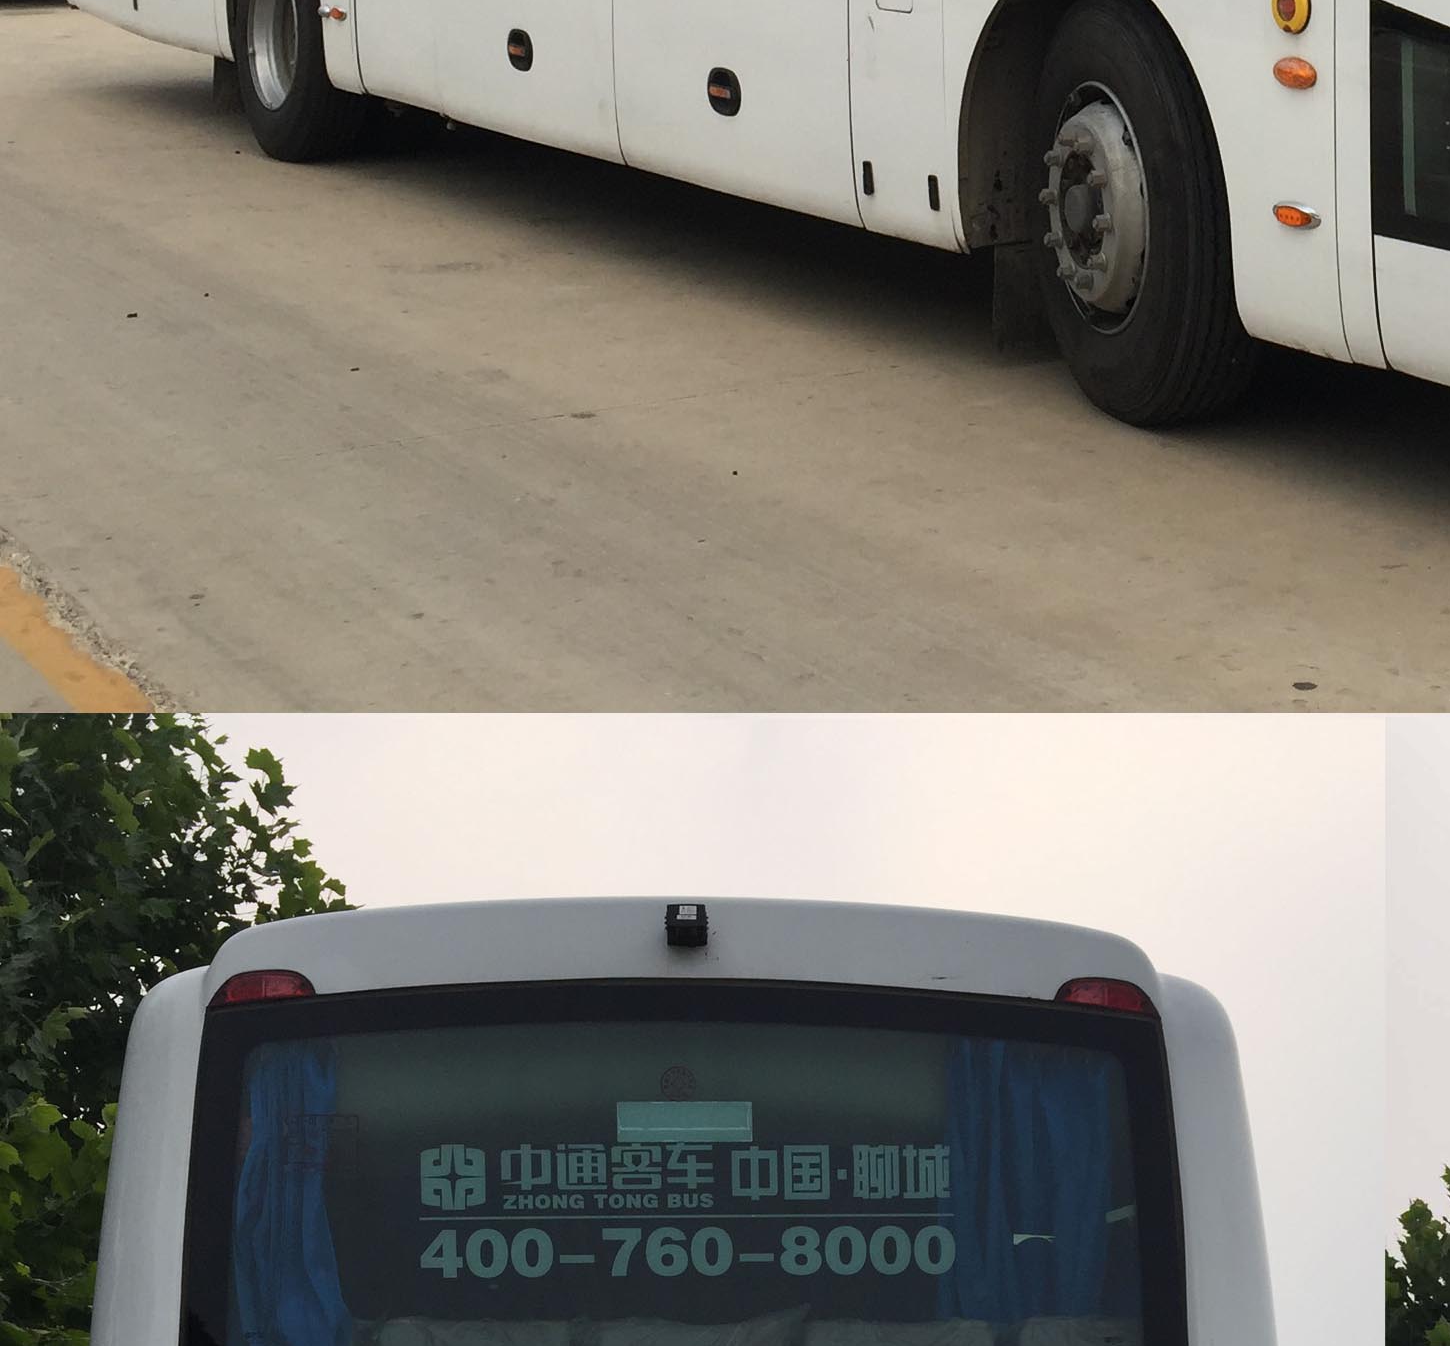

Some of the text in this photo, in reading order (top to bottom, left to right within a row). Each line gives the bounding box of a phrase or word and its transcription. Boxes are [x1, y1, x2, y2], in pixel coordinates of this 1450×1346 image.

[500, 1142, 951, 1201] 中通客车 中国·聊城
[503, 1192, 714, 1210] ZHONG TONG BUS
[420, 1225, 956, 1278] 400-760-8000
